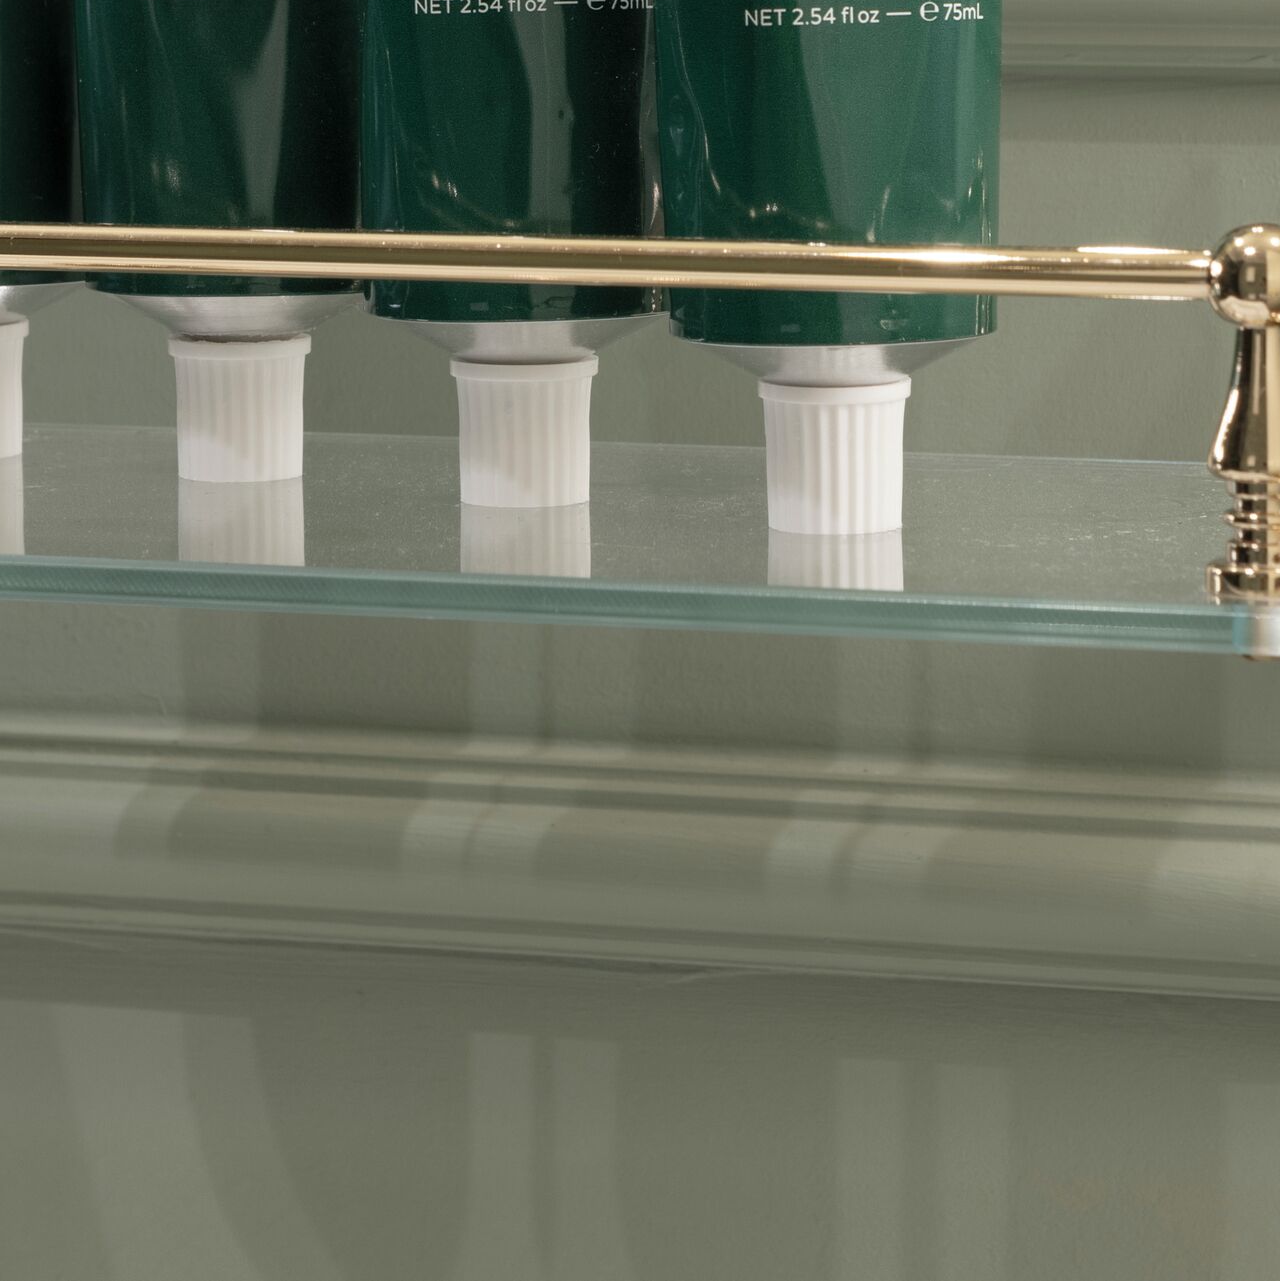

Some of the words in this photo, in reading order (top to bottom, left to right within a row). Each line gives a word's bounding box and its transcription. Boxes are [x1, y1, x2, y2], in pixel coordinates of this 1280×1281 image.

[525, 0, 547, 12] oz
[745, 9, 786, 26] NET
[792, 7, 836, 26] 2.54
[842, 6, 855, 24] fl
[858, 10, 879, 23] oz
